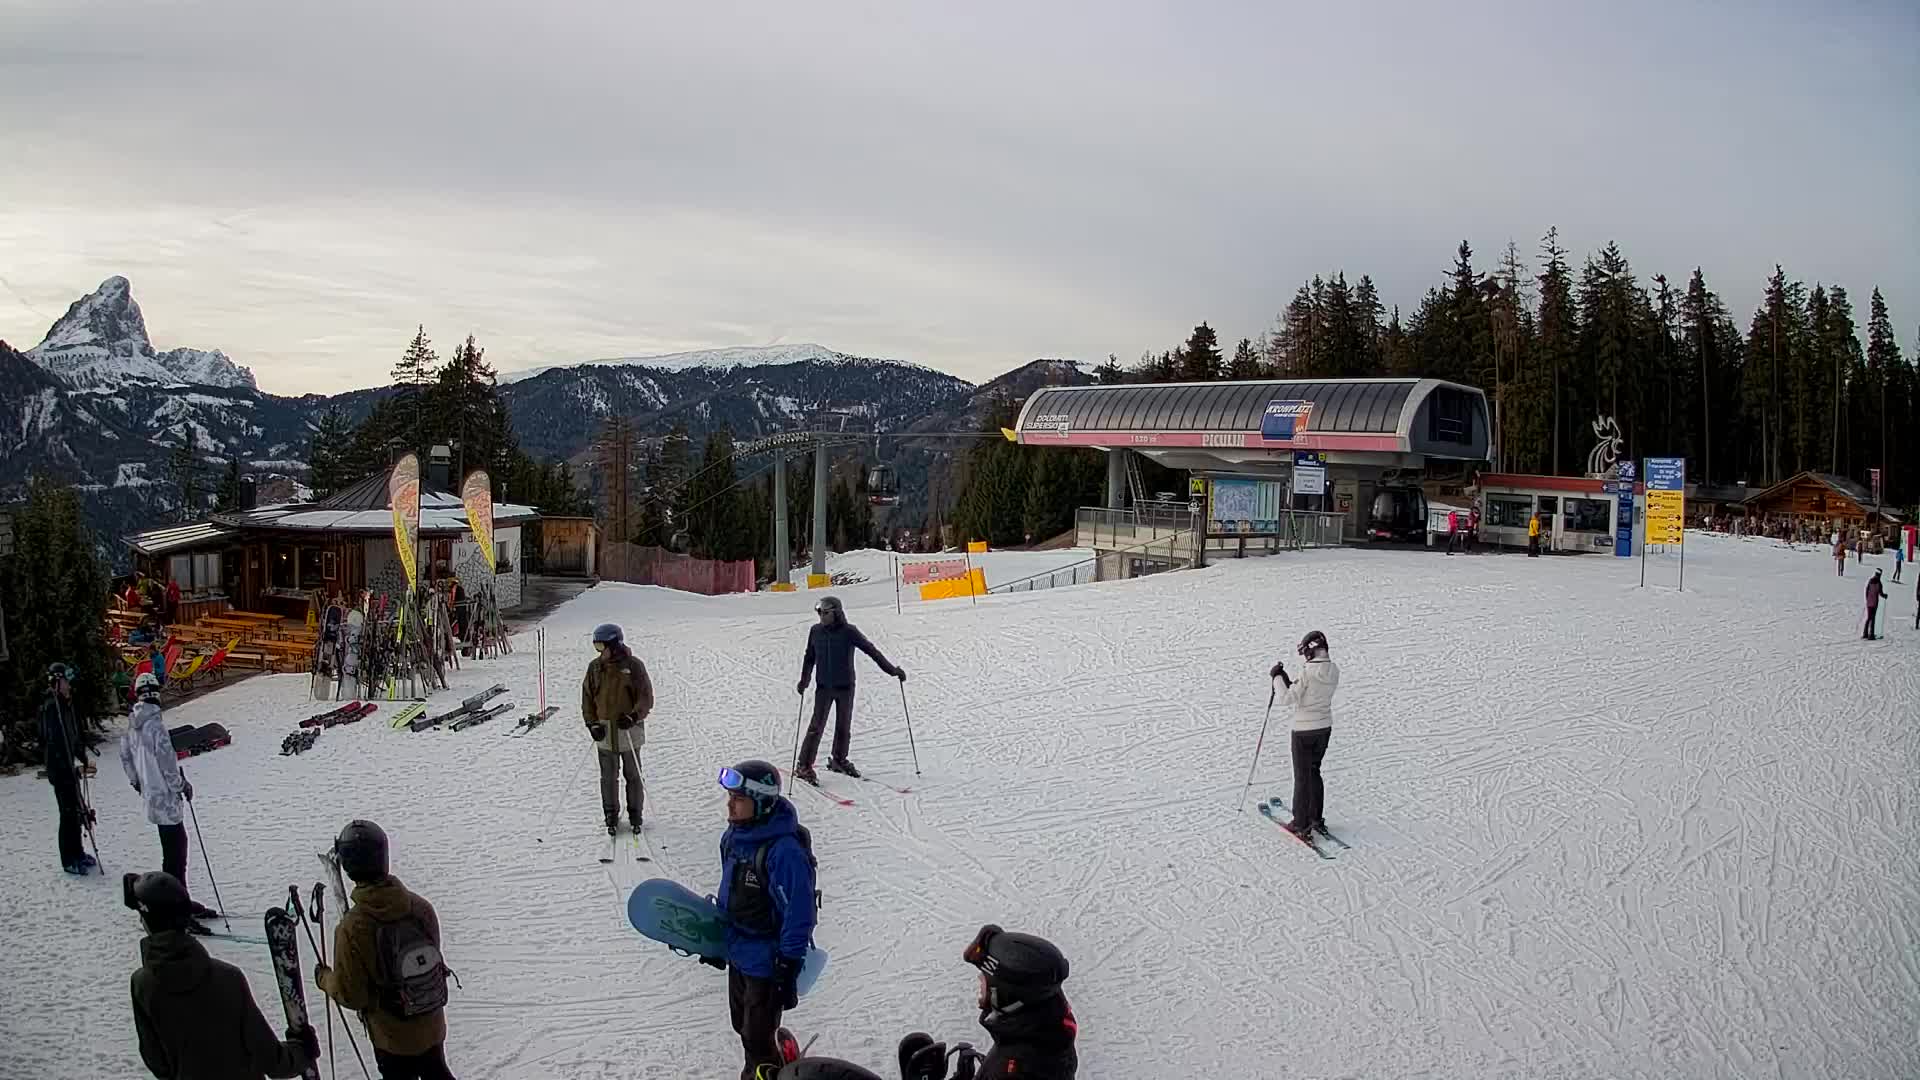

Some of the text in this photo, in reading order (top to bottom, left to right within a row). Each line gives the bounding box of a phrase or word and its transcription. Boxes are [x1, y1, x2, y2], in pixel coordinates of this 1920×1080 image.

[1266, 405, 1312, 413] KRONPLATZ
[1036, 414, 1068, 422] DOLOMITI
[1202, 434, 1244, 447] PICULIN
